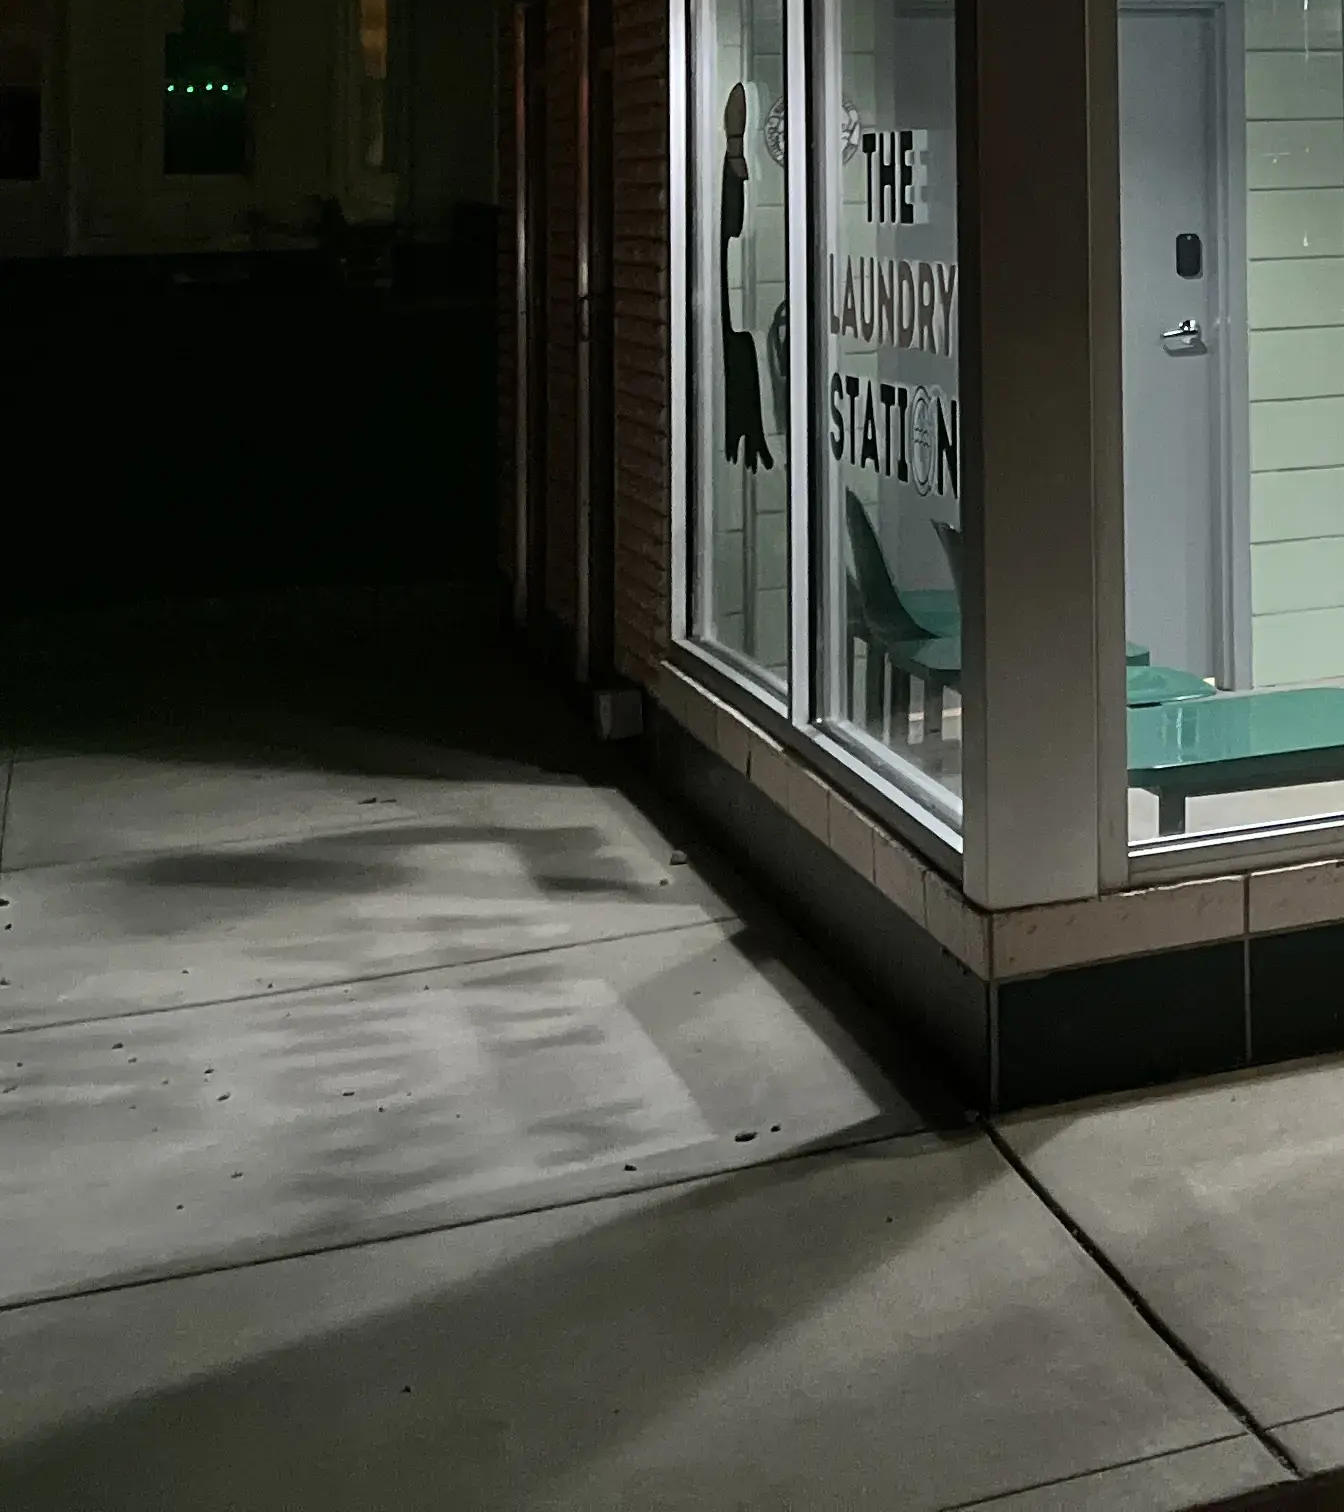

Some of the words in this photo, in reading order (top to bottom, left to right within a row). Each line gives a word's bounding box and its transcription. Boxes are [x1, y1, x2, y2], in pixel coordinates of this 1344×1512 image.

[862, 130, 914, 225] THE
[829, 252, 958, 358] LAUNDRY
[829, 371, 959, 500] STATION
